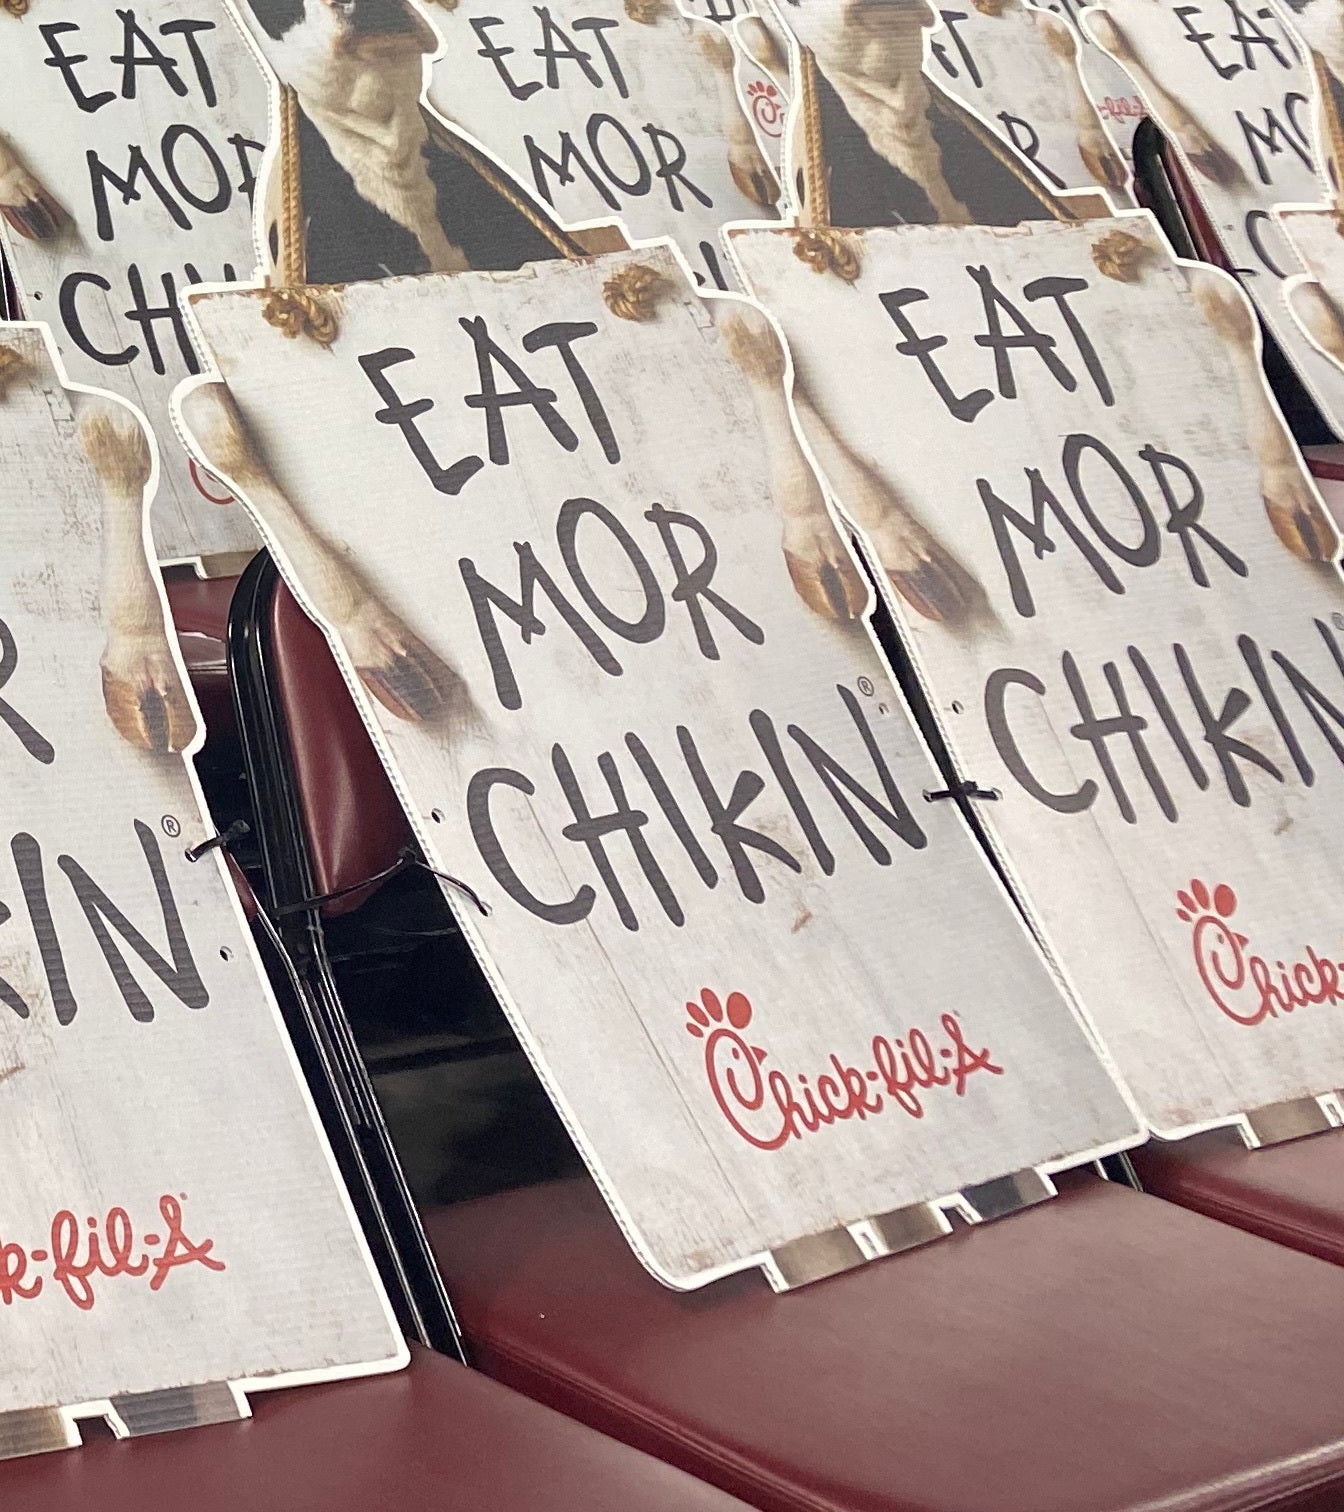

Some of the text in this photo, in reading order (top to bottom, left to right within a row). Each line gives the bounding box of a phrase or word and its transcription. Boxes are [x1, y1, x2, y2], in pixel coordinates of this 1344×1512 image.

[40, 8, 216, 113] EAT
[467, 6, 631, 100] EAT
[523, 112, 713, 213] MOR
[357, 313, 622, 496] EAT
[878, 264, 1116, 424] EAT
[457, 497, 766, 711] MOR
[975, 433, 1249, 619] MOR
[464, 682, 928, 933] CHIKIN
[984, 617, 1344, 824] CHIKIN
[685, 986, 1005, 1152] Chick-fil-A
